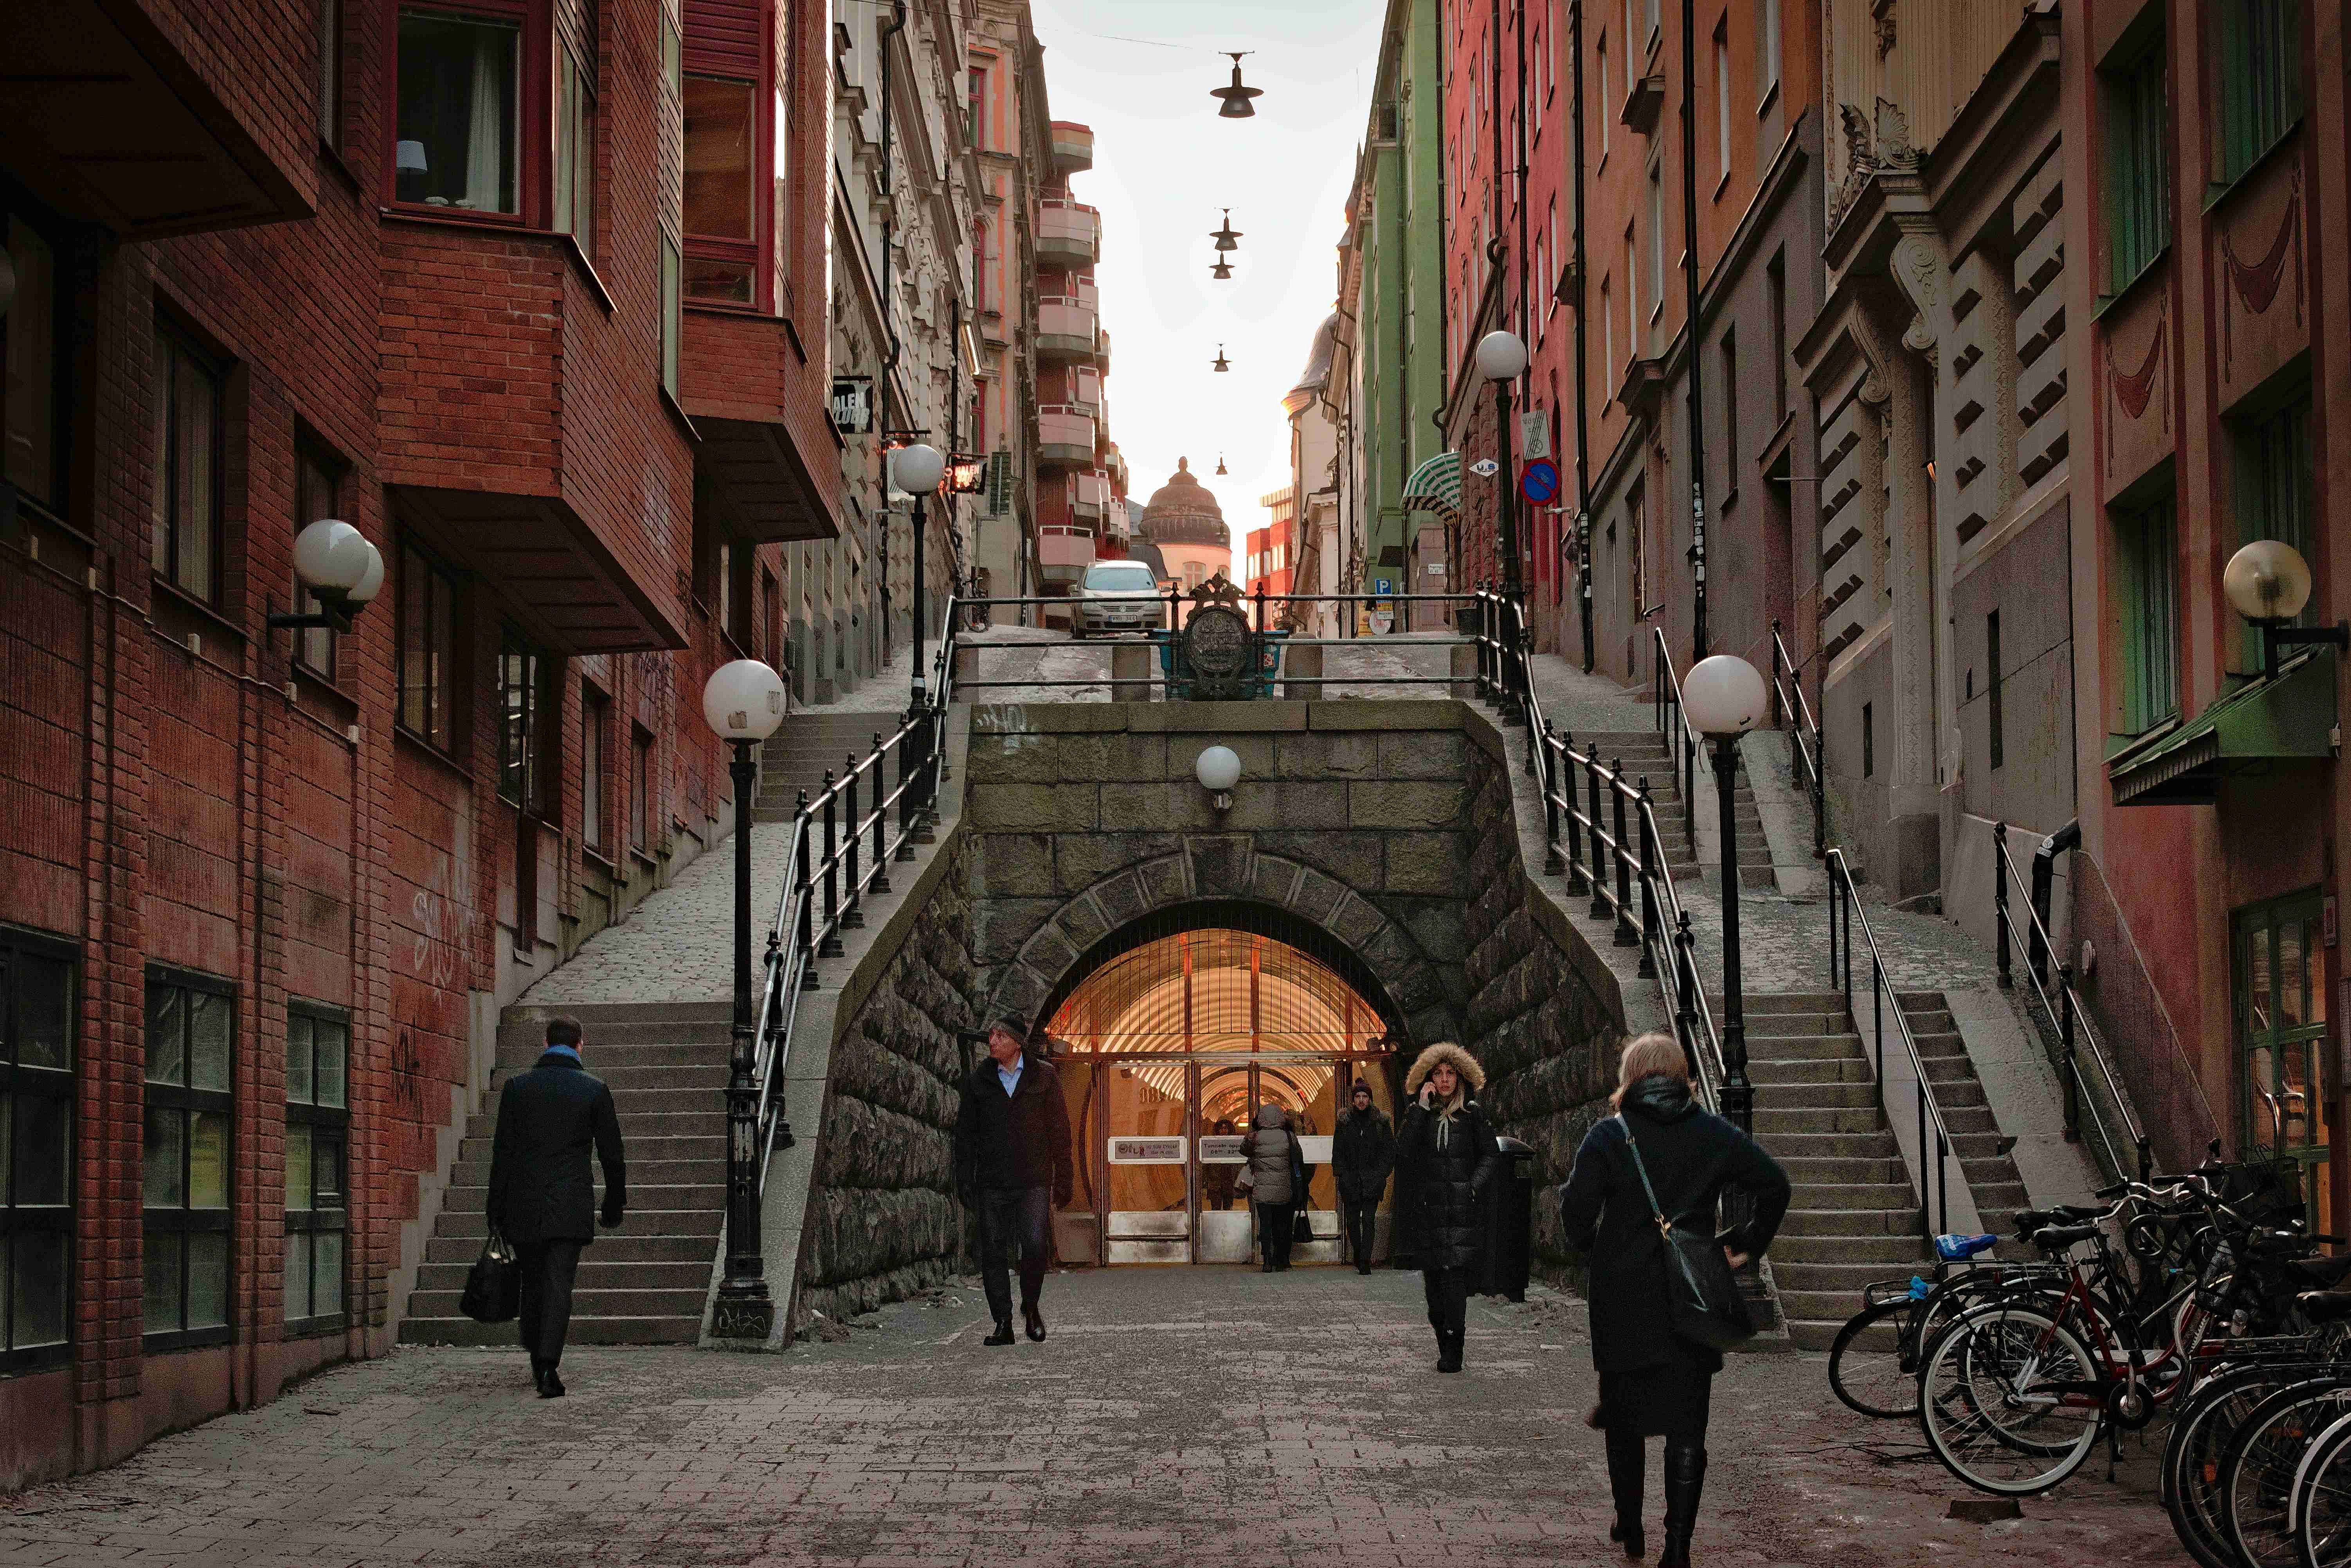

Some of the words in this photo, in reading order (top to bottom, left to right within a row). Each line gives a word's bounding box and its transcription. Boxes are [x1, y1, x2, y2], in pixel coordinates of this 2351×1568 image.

[833, 392, 865, 410] ALEN
[833, 407, 869, 424] LUBB
[1380, 580, 1389, 593] P
